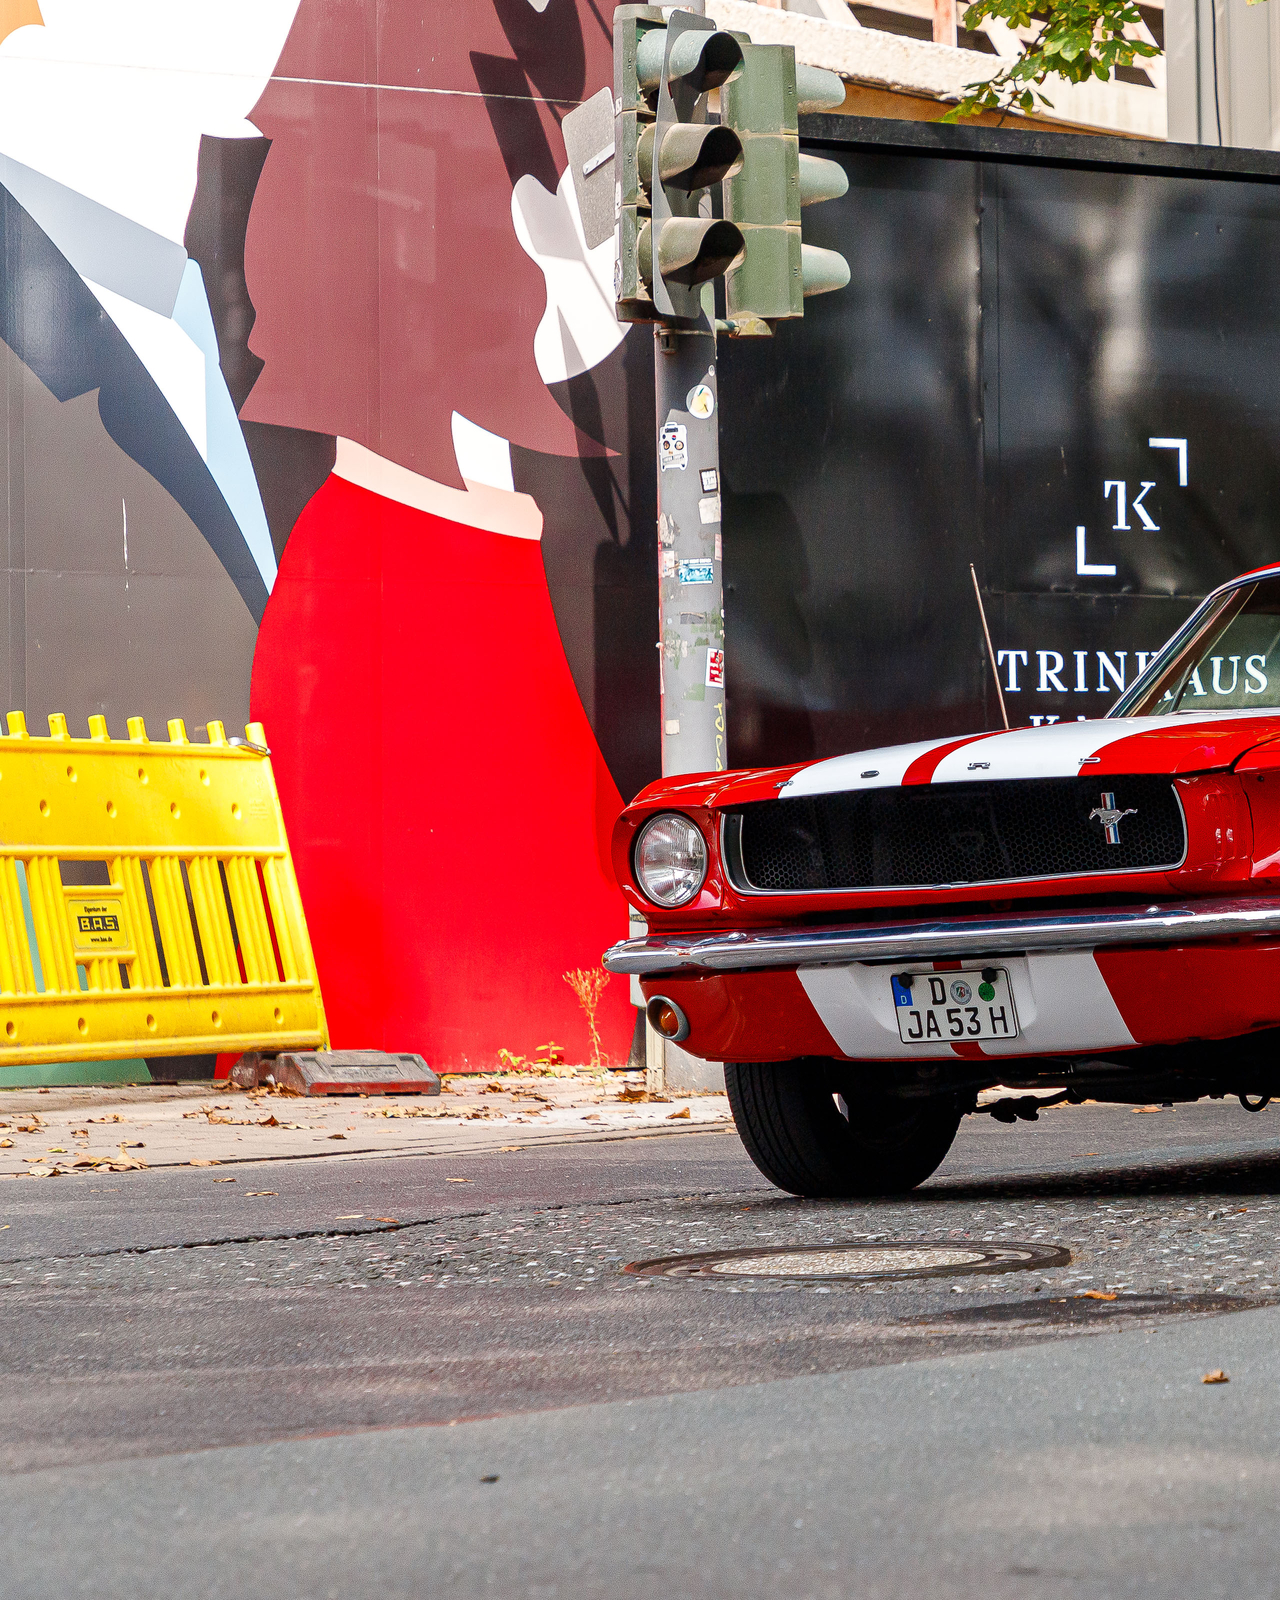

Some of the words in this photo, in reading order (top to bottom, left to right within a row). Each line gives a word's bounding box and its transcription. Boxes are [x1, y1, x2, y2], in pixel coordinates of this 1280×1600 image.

[80, 916, 119, 931] B.A.S.
[928, 977, 947, 1005] D
[901, 995, 908, 1005] D
